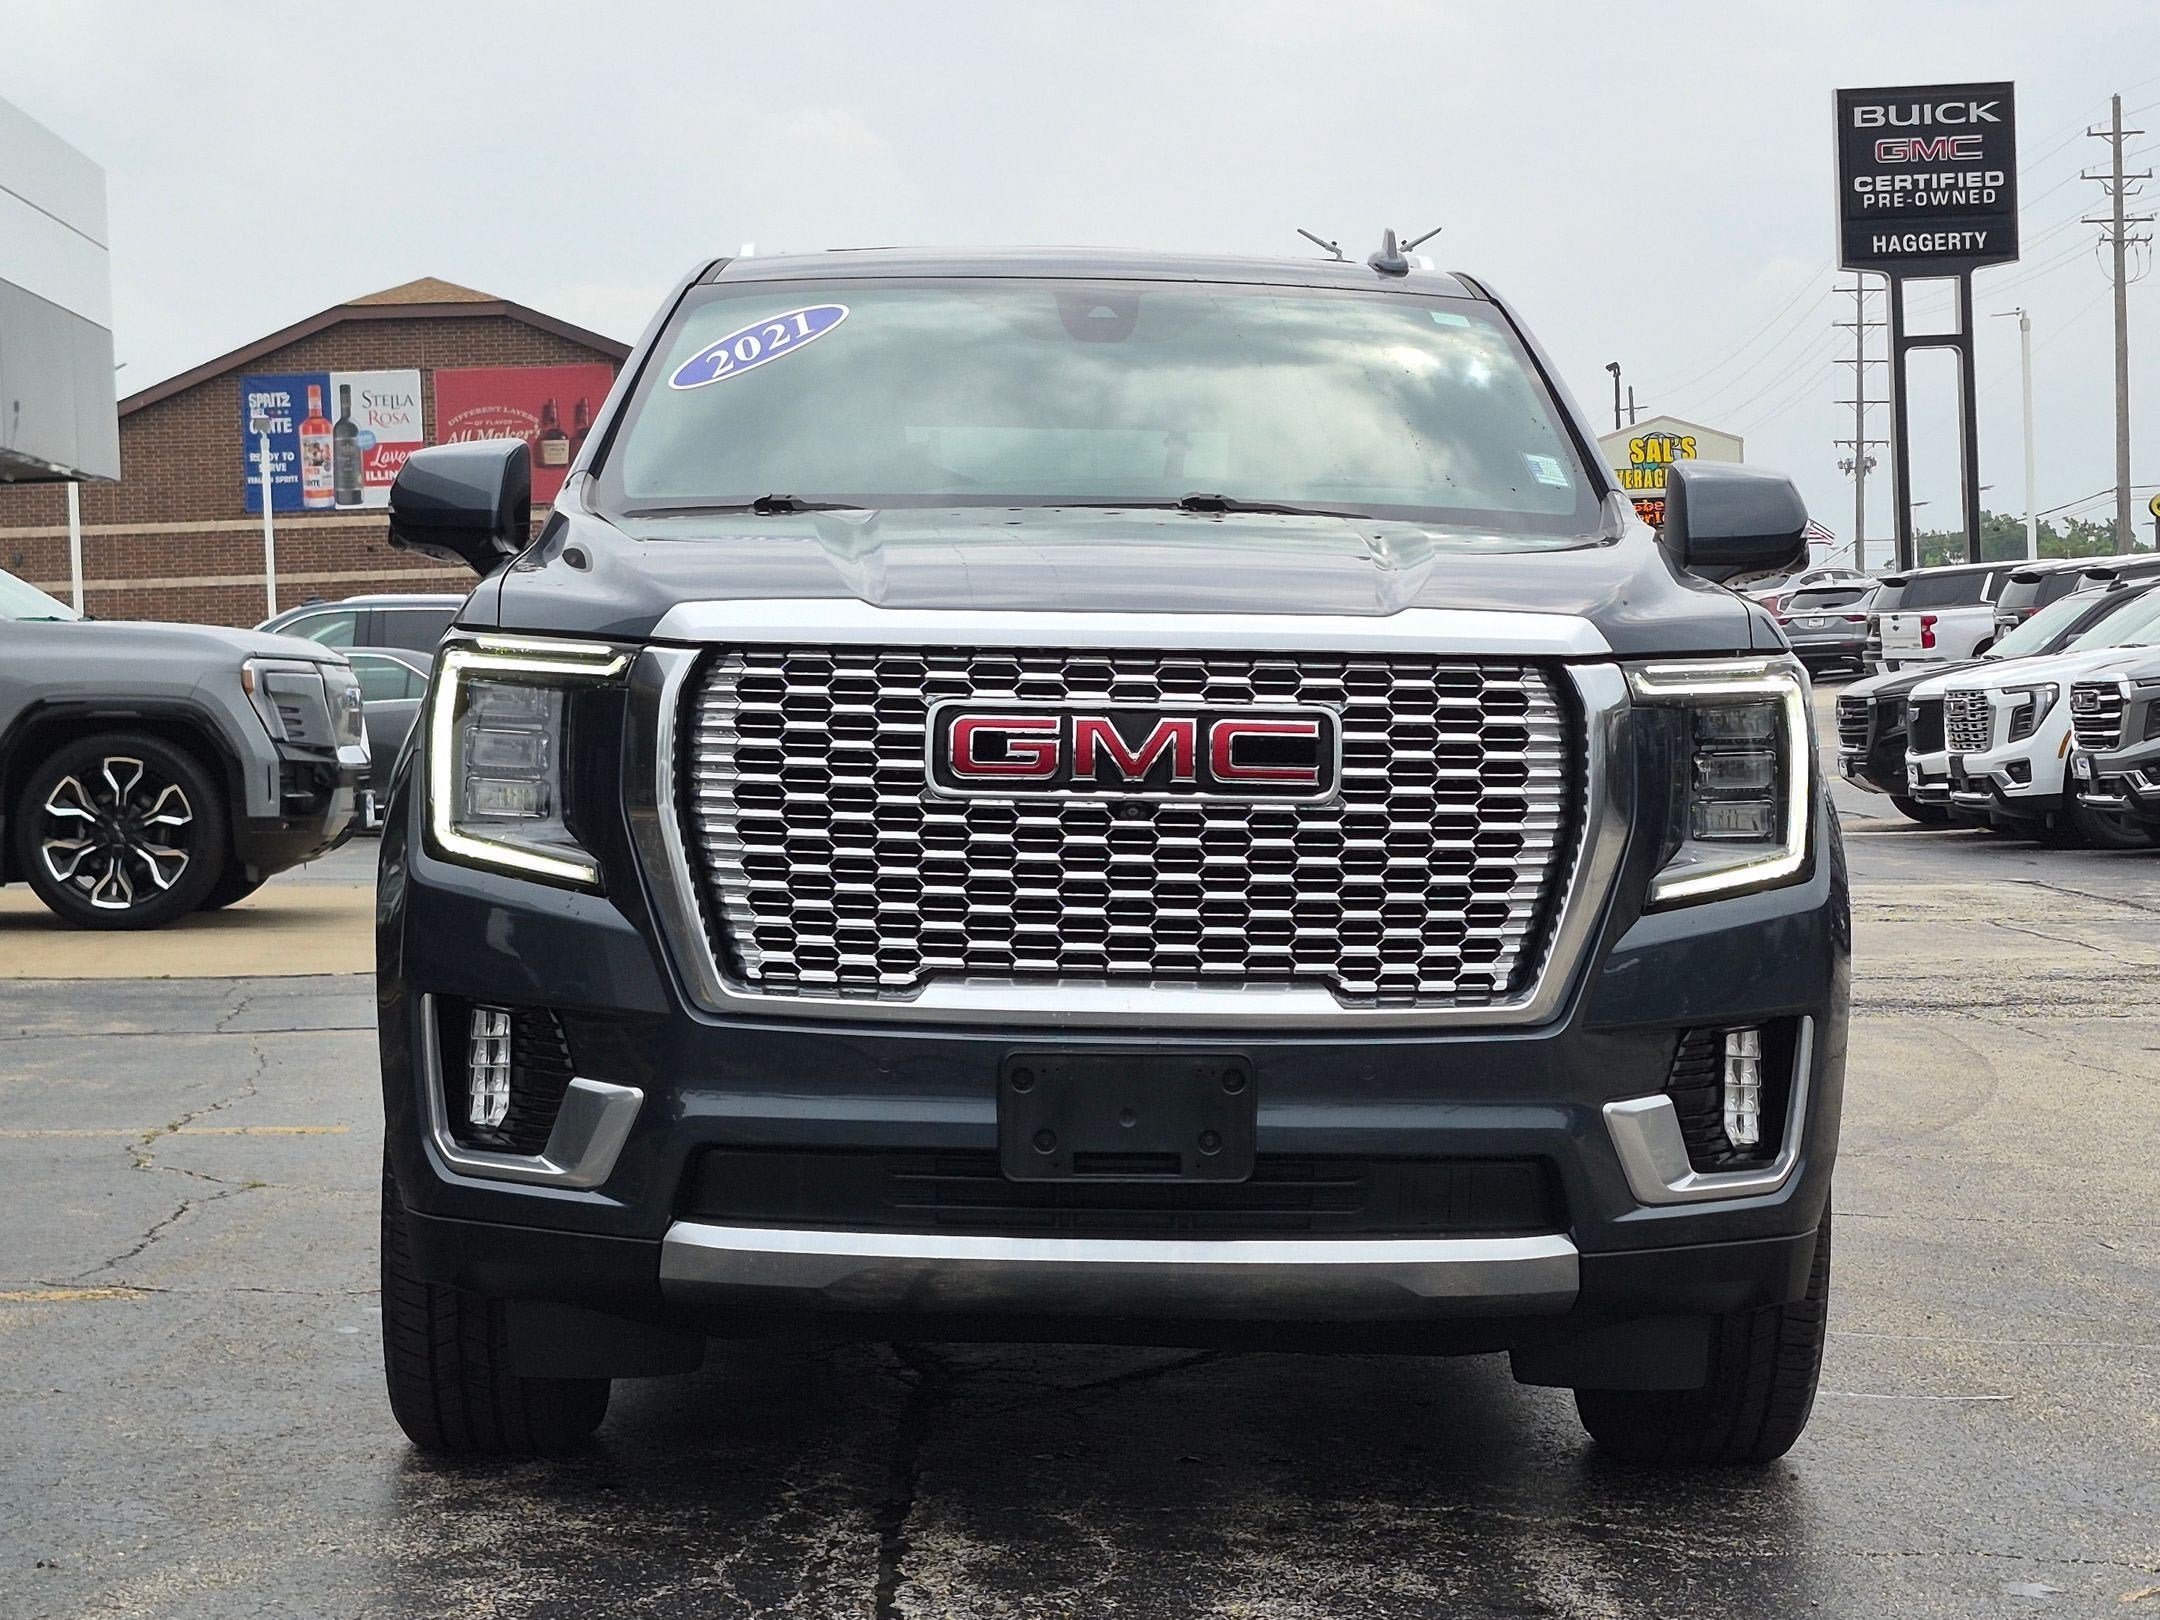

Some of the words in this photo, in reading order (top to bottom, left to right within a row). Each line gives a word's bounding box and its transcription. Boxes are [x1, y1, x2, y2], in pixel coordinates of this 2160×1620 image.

[1853, 101, 2002, 128] BUICK
[1875, 135, 1983, 164] GMC
[1854, 171, 2004, 192] CERTIFIED
[1863, 189, 1996, 209] PRE-OWNED
[1872, 231, 1987, 254] HAGGERTY
[705, 312, 816, 378] 2021
[248, 391, 291, 408] SPRITZ
[448, 406, 502, 426] DIFFERENT
[503, 407, 540, 424] LAYERS
[447, 429, 472, 444] All
[249, 451, 280, 462] REDY
[281, 451, 295, 462] TO
[1629, 436, 1697, 464] SAL'S
[258, 463, 287, 473] SRVE
[948, 714, 1320, 786] GMC
